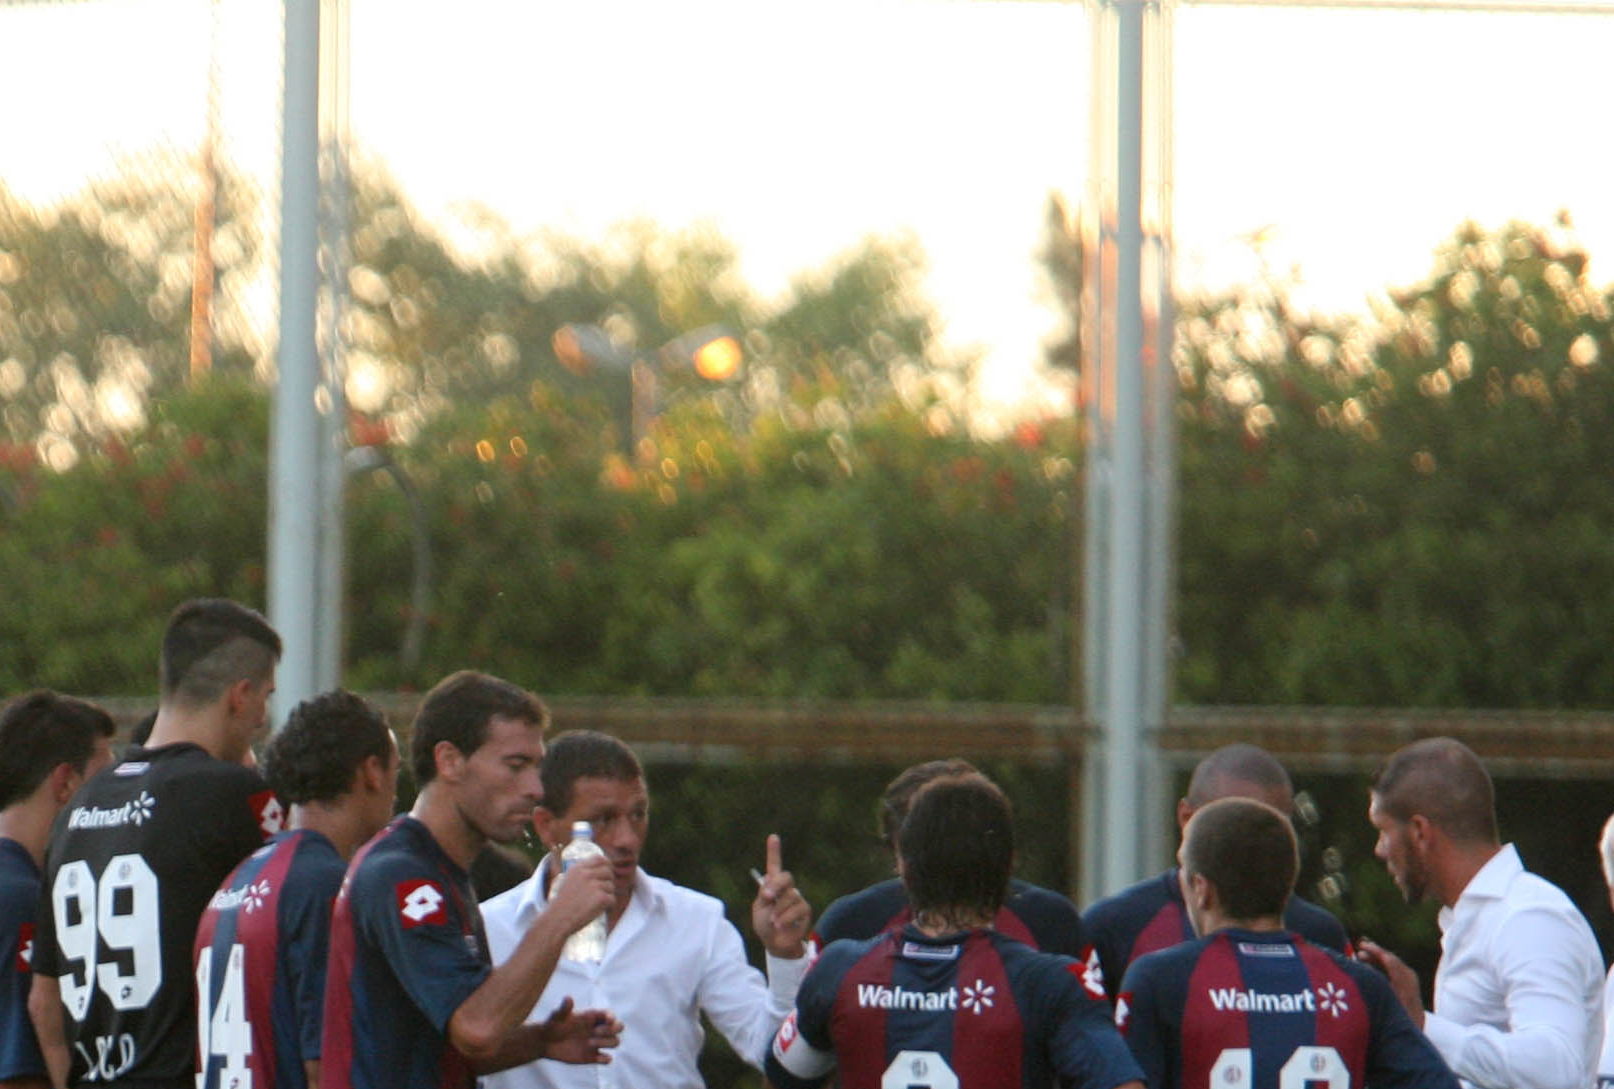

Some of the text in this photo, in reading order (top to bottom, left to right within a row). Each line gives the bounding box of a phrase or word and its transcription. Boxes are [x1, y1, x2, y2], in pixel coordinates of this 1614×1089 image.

[68, 801, 132, 831] Walmart
[52, 853, 162, 1022] 99
[857, 984, 958, 1012] Walmart
[1208, 988, 1316, 1013] Walmart
